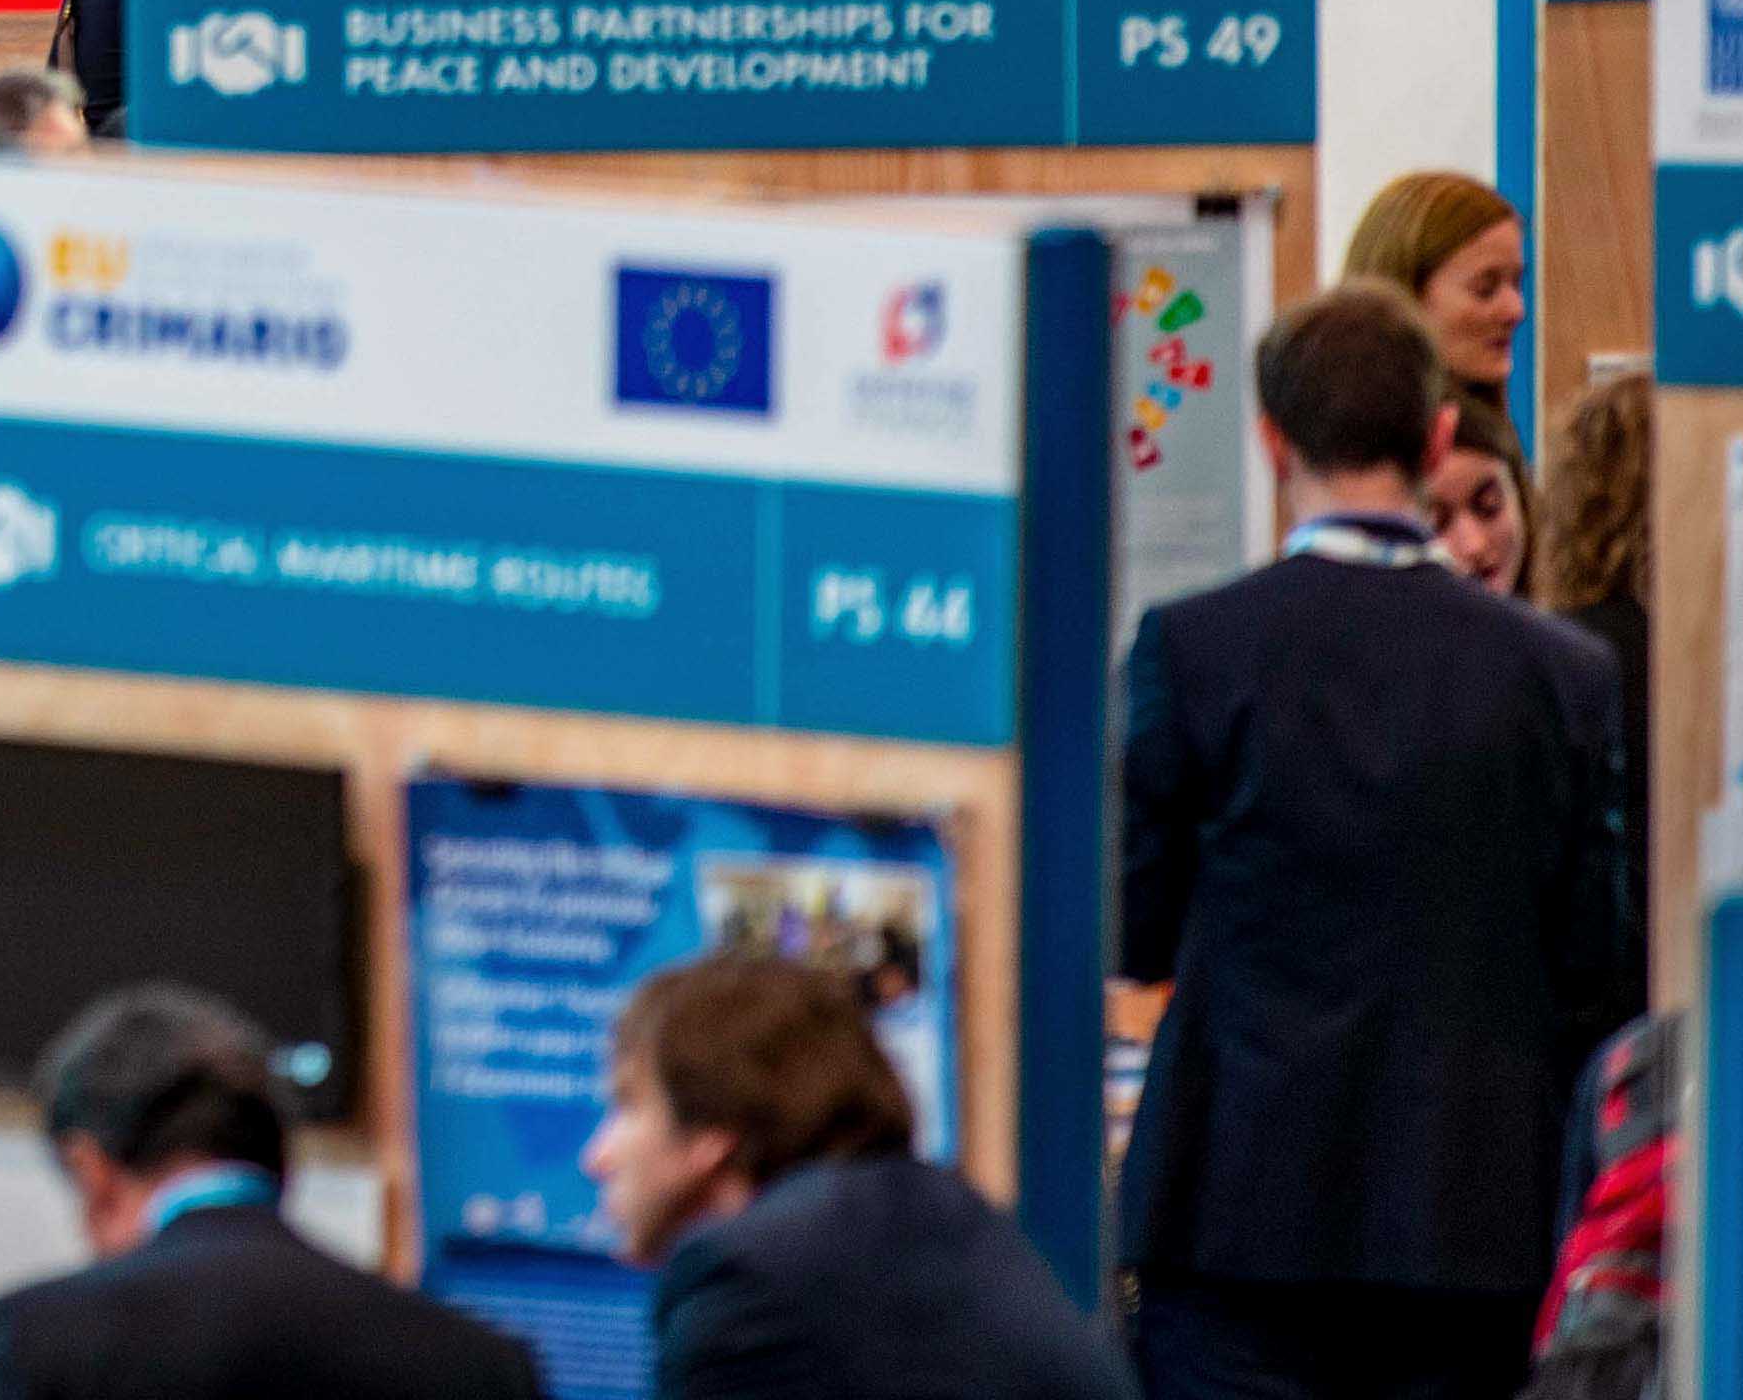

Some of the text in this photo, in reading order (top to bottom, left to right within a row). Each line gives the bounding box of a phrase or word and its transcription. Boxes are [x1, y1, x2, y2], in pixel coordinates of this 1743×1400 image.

[345, 1, 994, 46] BUSINESS PARTNERSHIPS FOR
[1119, 14, 1282, 68] PS 49
[345, 50, 931, 94] PEACE AND DEVELOPMENT
[818, 569, 884, 641] PS
